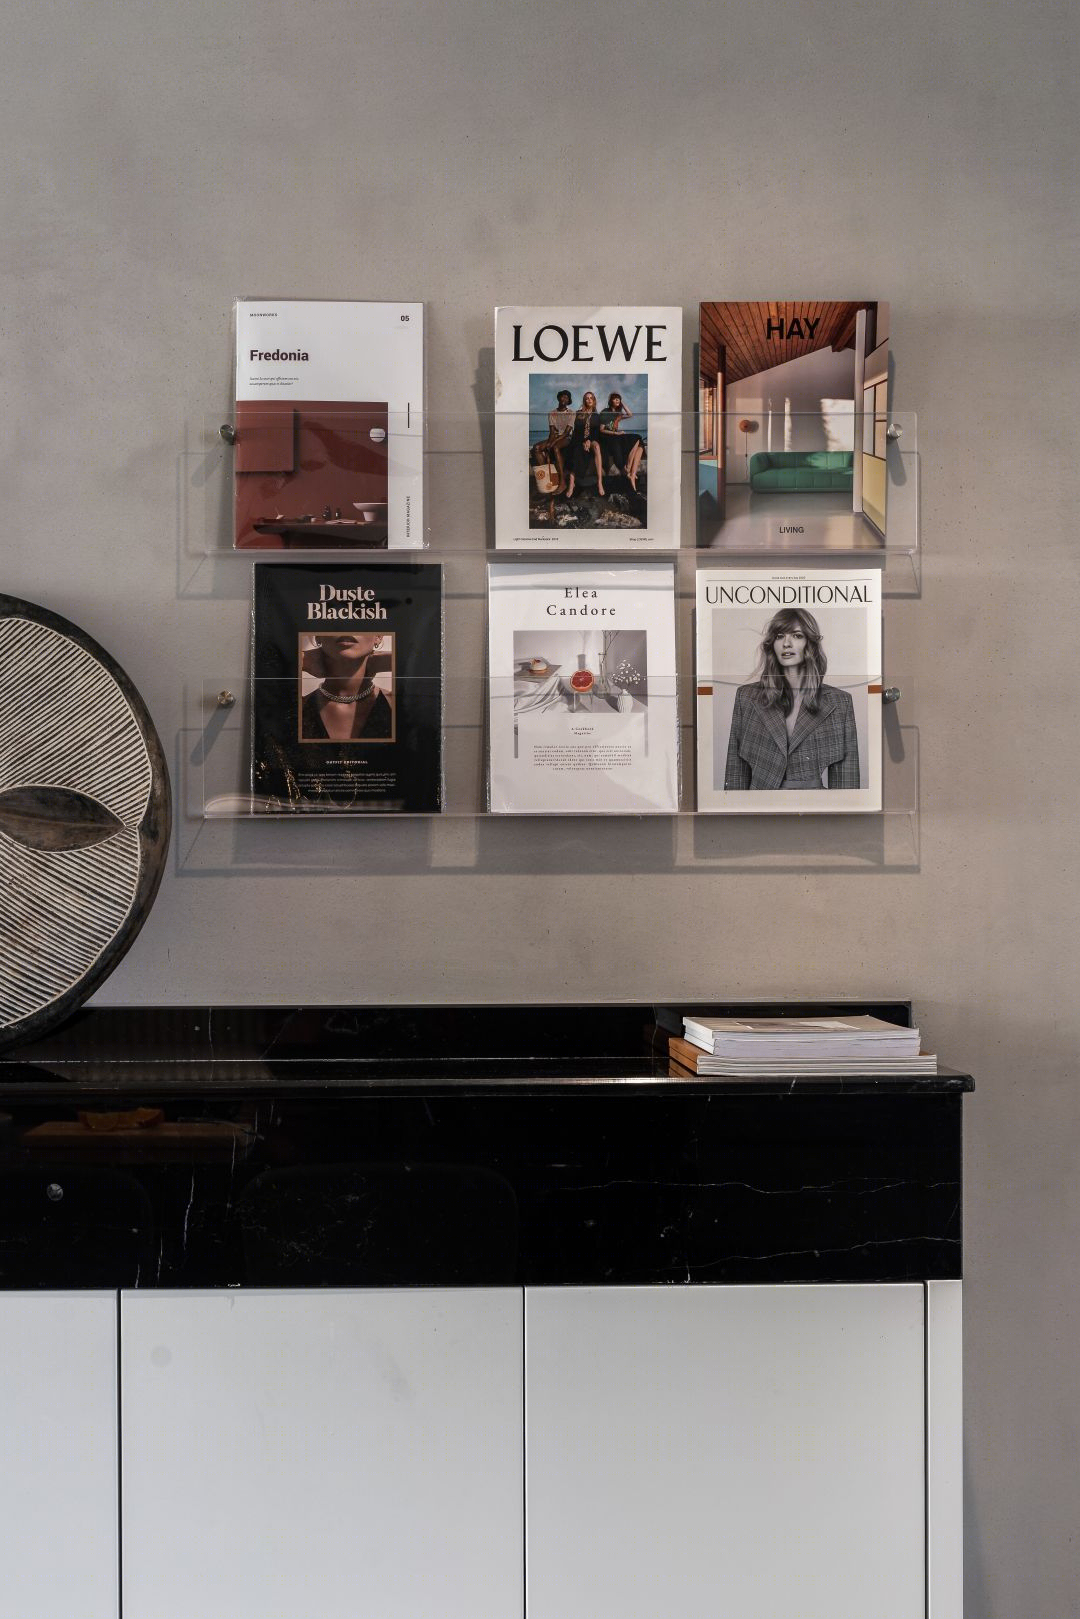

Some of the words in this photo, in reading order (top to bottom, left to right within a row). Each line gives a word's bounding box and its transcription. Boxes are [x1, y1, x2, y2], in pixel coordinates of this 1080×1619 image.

[766, 317, 820, 340] HAY
[511, 324, 667, 362] LOEWE
[249, 348, 309, 361] Fredonia
[319, 584, 375, 601] Duste
[564, 586, 598, 599] Elea
[705, 585, 873, 604] UNCONDITIONAL
[307, 602, 387, 619] Blackish
[546, 604, 616, 616] Candore
